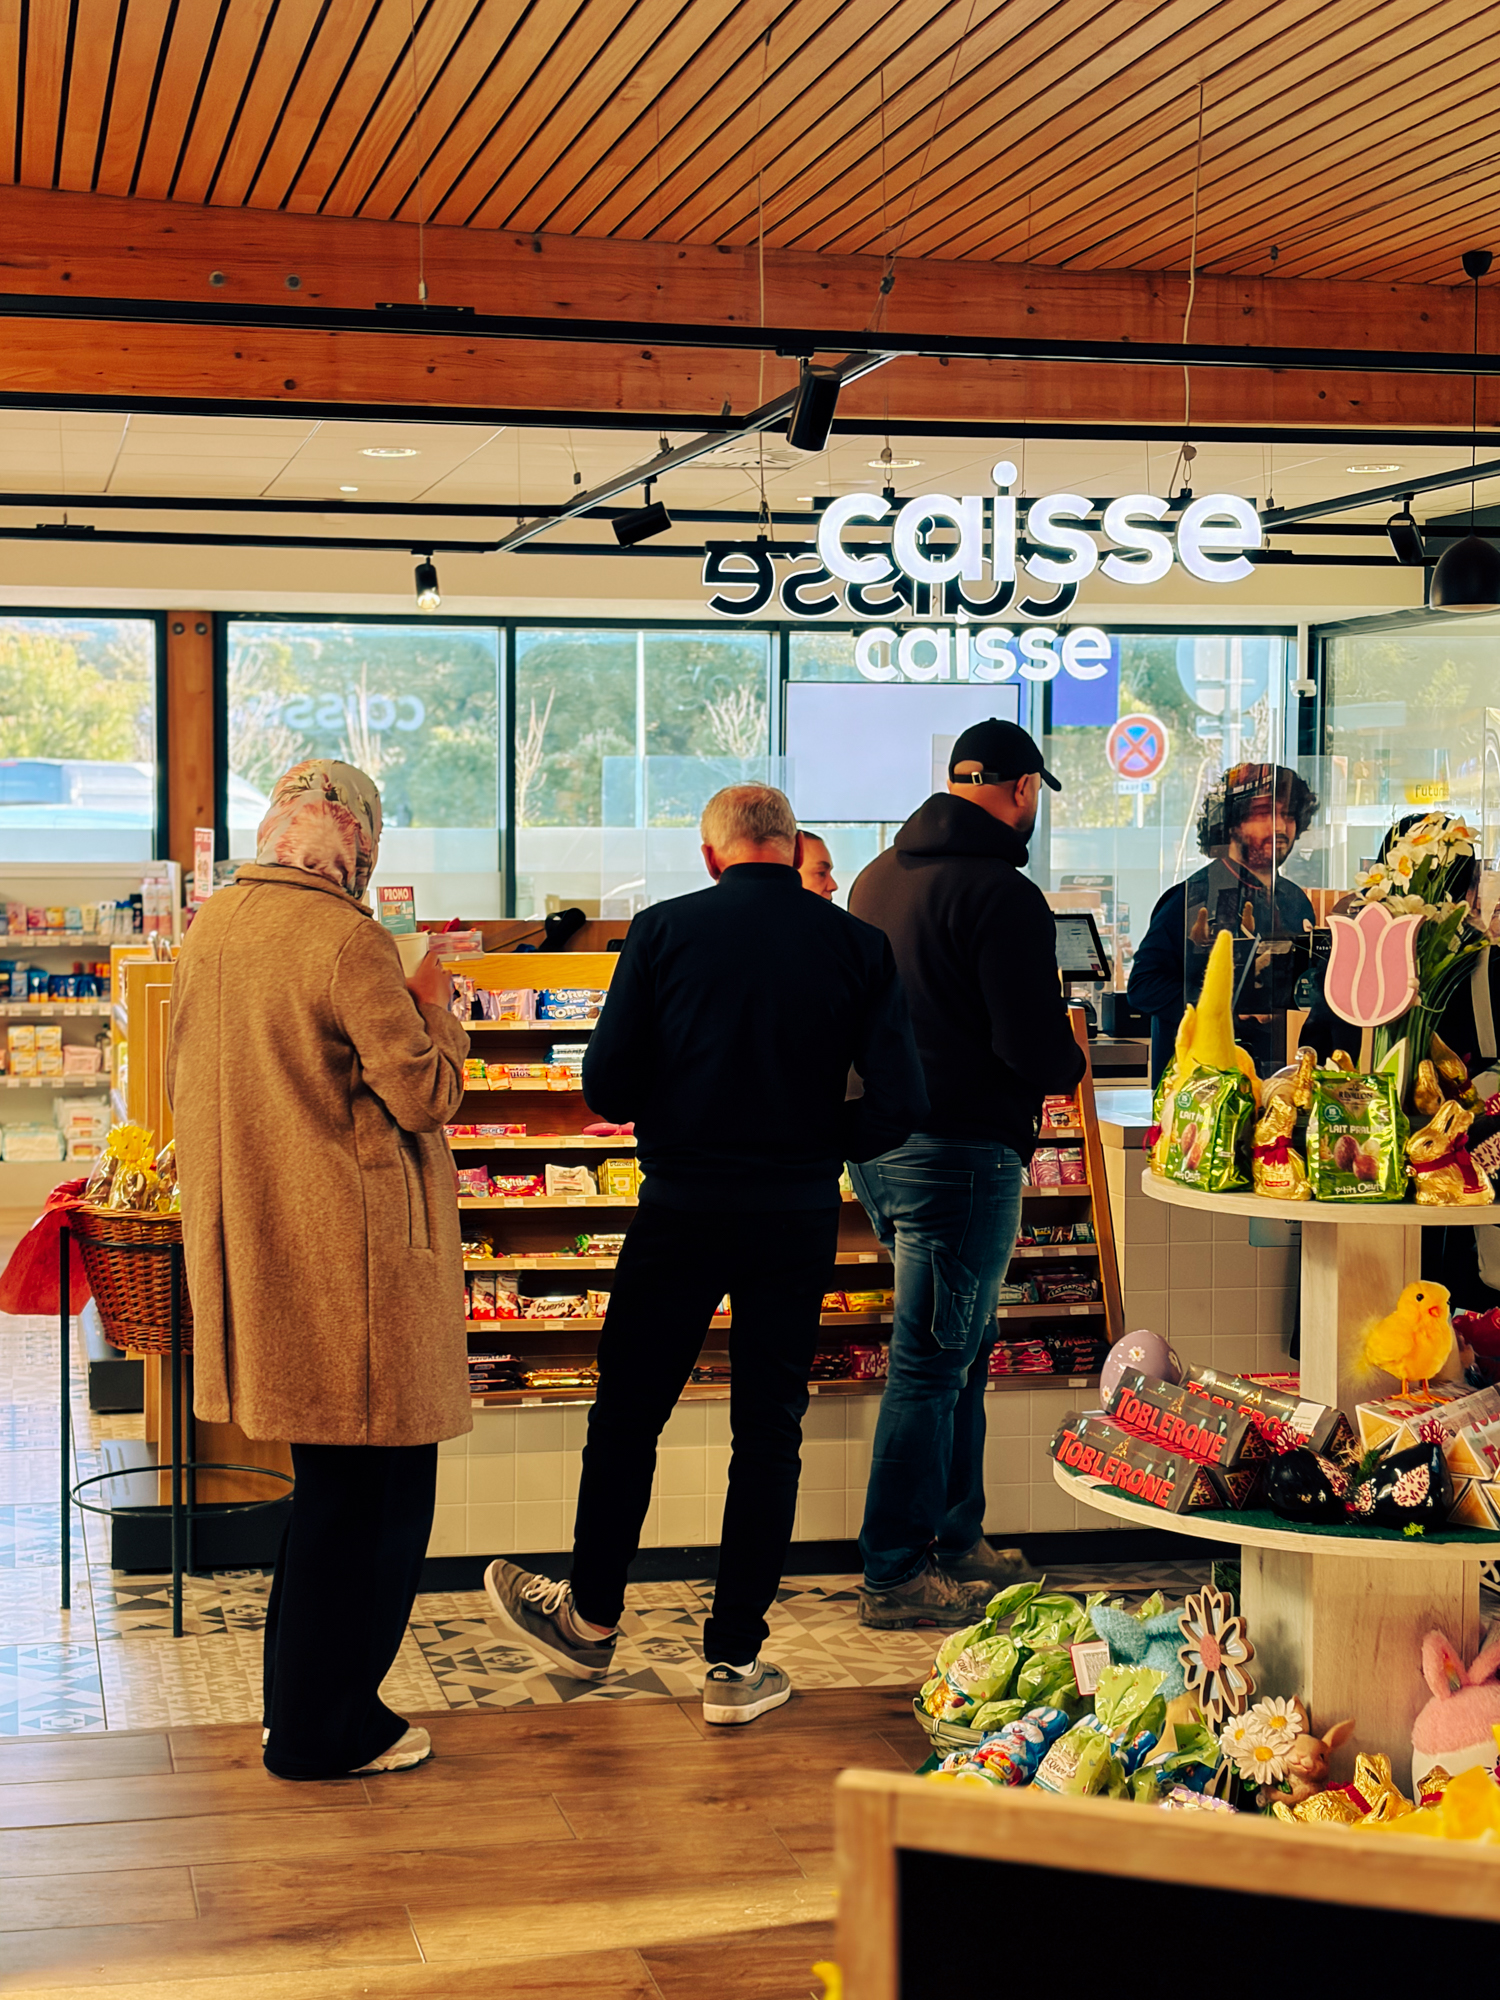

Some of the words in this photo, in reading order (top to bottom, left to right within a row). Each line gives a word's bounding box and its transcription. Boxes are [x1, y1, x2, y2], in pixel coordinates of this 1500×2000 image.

[816, 460, 1264, 585] caisse
[854, 610, 1112, 681] caisse
[384, 888, 409, 900] PROMO
[1329, 1124, 1348, 1134] LAIT
[536, 1301, 566, 1314] bueno
[1113, 1386, 1228, 1463] TOBLERONE
[1055, 1429, 1176, 1508] TOBLERONE
